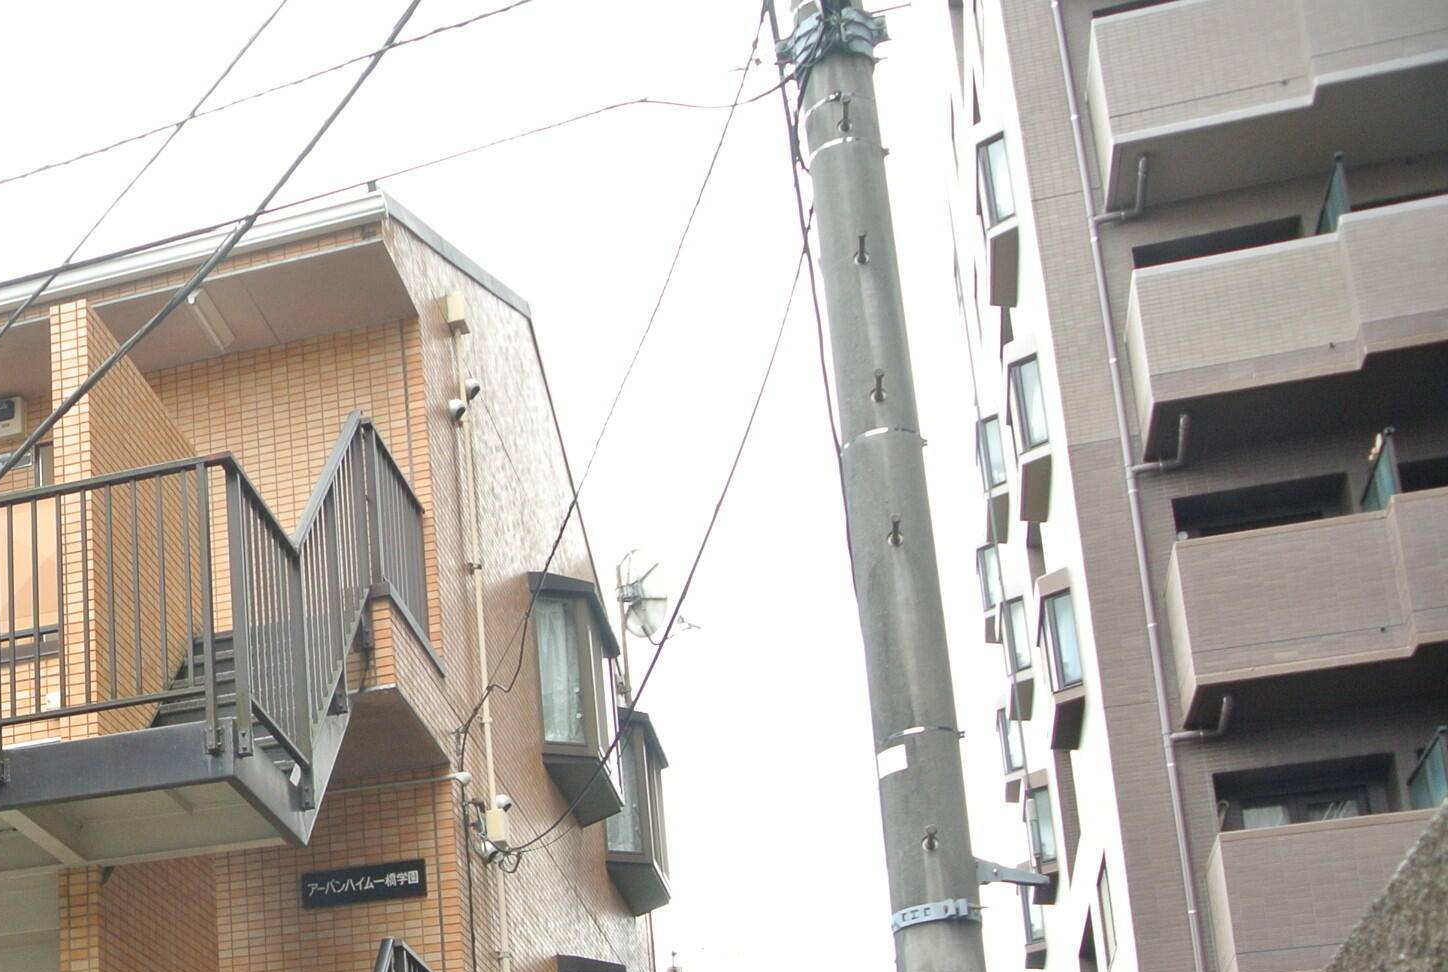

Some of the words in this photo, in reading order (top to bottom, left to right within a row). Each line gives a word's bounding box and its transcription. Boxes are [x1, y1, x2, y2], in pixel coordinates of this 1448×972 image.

[307, 870, 419, 897] アーバンハイム一橋学園
